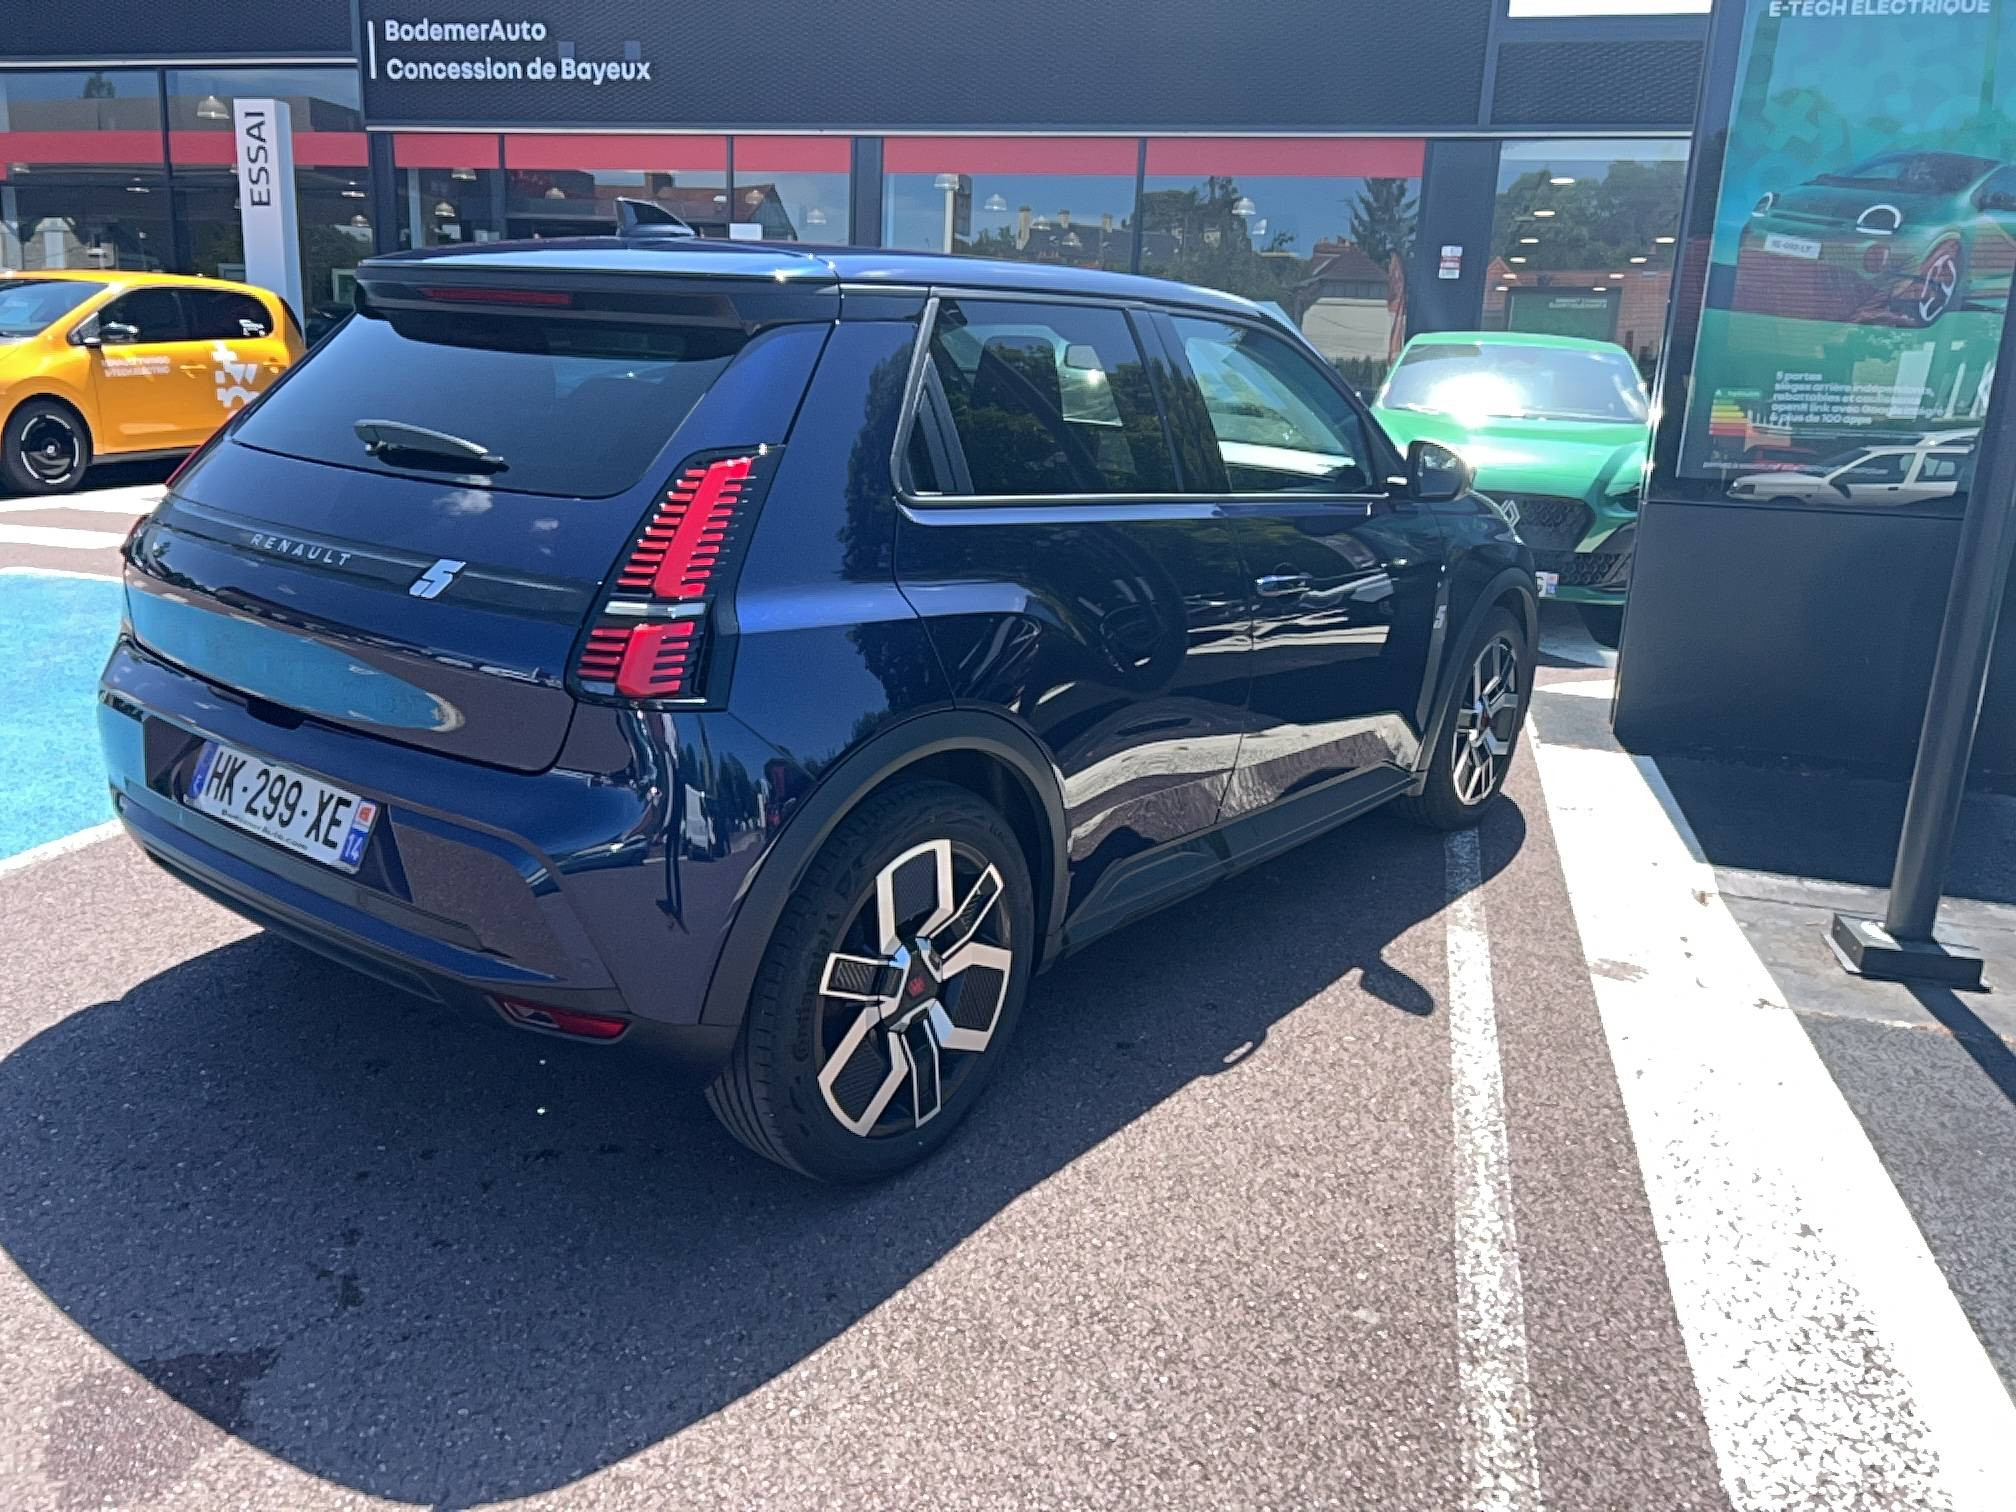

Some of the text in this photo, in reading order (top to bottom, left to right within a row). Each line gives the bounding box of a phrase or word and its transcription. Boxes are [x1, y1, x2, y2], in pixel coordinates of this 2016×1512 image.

[1768, 0, 1847, 17] E-TECH
[385, 17, 546, 41] BodemerAuto
[386, 56, 651, 85] Concession de Bayeux
[244, 111, 271, 207] ESSAI
[1822, 414, 1842, 423] 100
[251, 533, 352, 567] RENAULT
[408, 558, 467, 600] 5
[345, 834, 364, 861] 14
